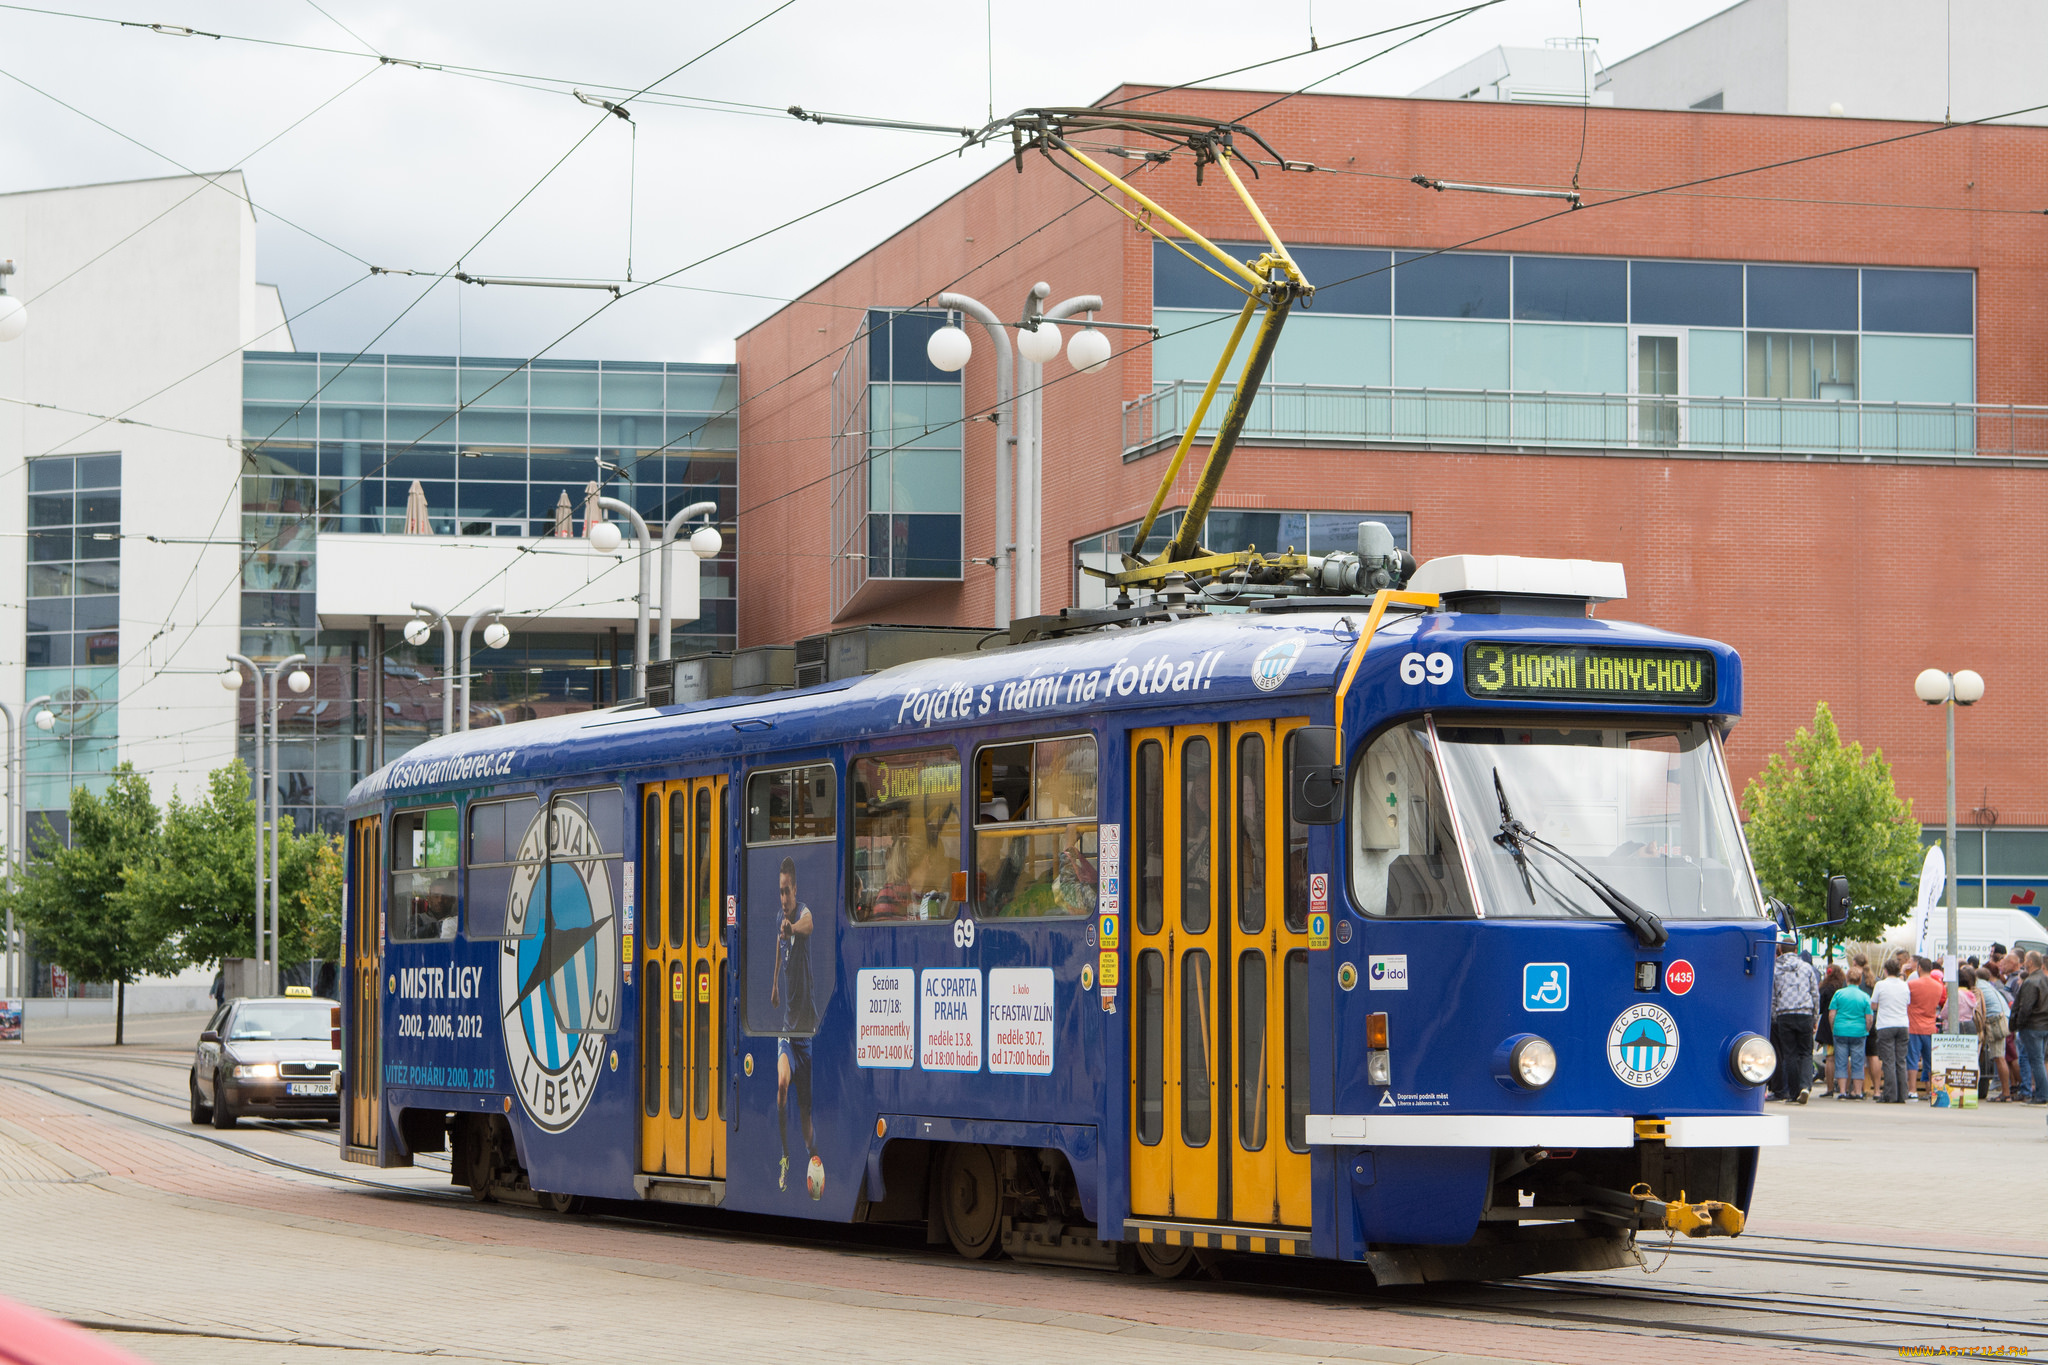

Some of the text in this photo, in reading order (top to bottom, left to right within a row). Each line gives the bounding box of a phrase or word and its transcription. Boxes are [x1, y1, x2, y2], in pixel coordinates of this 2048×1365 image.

[1399, 651, 1454, 686] 69
[1476, 646, 1702, 692] 3 HORNÍ HANYCHOV
[898, 650, 1225, 728] Pojďte s námi na fotbal!
[877, 762, 889, 803] 3
[523, 814, 597, 885] SLOVAN
[953, 918, 975, 948] 69
[400, 966, 482, 999] MISTR LIGY
[872, 975, 899, 990] Sezóna
[1386, 968, 1406, 979] idol
[1669, 971, 1692, 984] 1435
[925, 978, 977, 997] AC SPARTA
[1012, 984, 1030, 995] 1. kolo
[869, 999, 902, 1016] 2017/18:
[934, 1002, 968, 1021] PRAHA
[990, 1002, 1053, 1022] FC FASTAV ZLÍN
[399, 1014, 482, 1040] 2002, 2006, 2012
[860, 1021, 910, 1040] permanentky
[1615, 1008, 1673, 1034] FC SLOVAN
[928, 1030, 973, 1047] neděle 13.8.
[997, 1029, 1045, 1046] neděle 30.7.
[521, 989, 608, 1116] LIBEREC
[857, 1048, 866, 1060] za
[903, 1044, 913, 1060] Kč
[923, 1051, 978, 1067] od 18:00 hodin
[991, 1051, 1050, 1067] od 17:00 hodin
[385, 1060, 495, 1090] VÍTĚZ POHÁRU 2000, 2015
[1616, 1060, 1669, 1083] LIBEREC
[293, 1084, 308, 1093] 4L1
